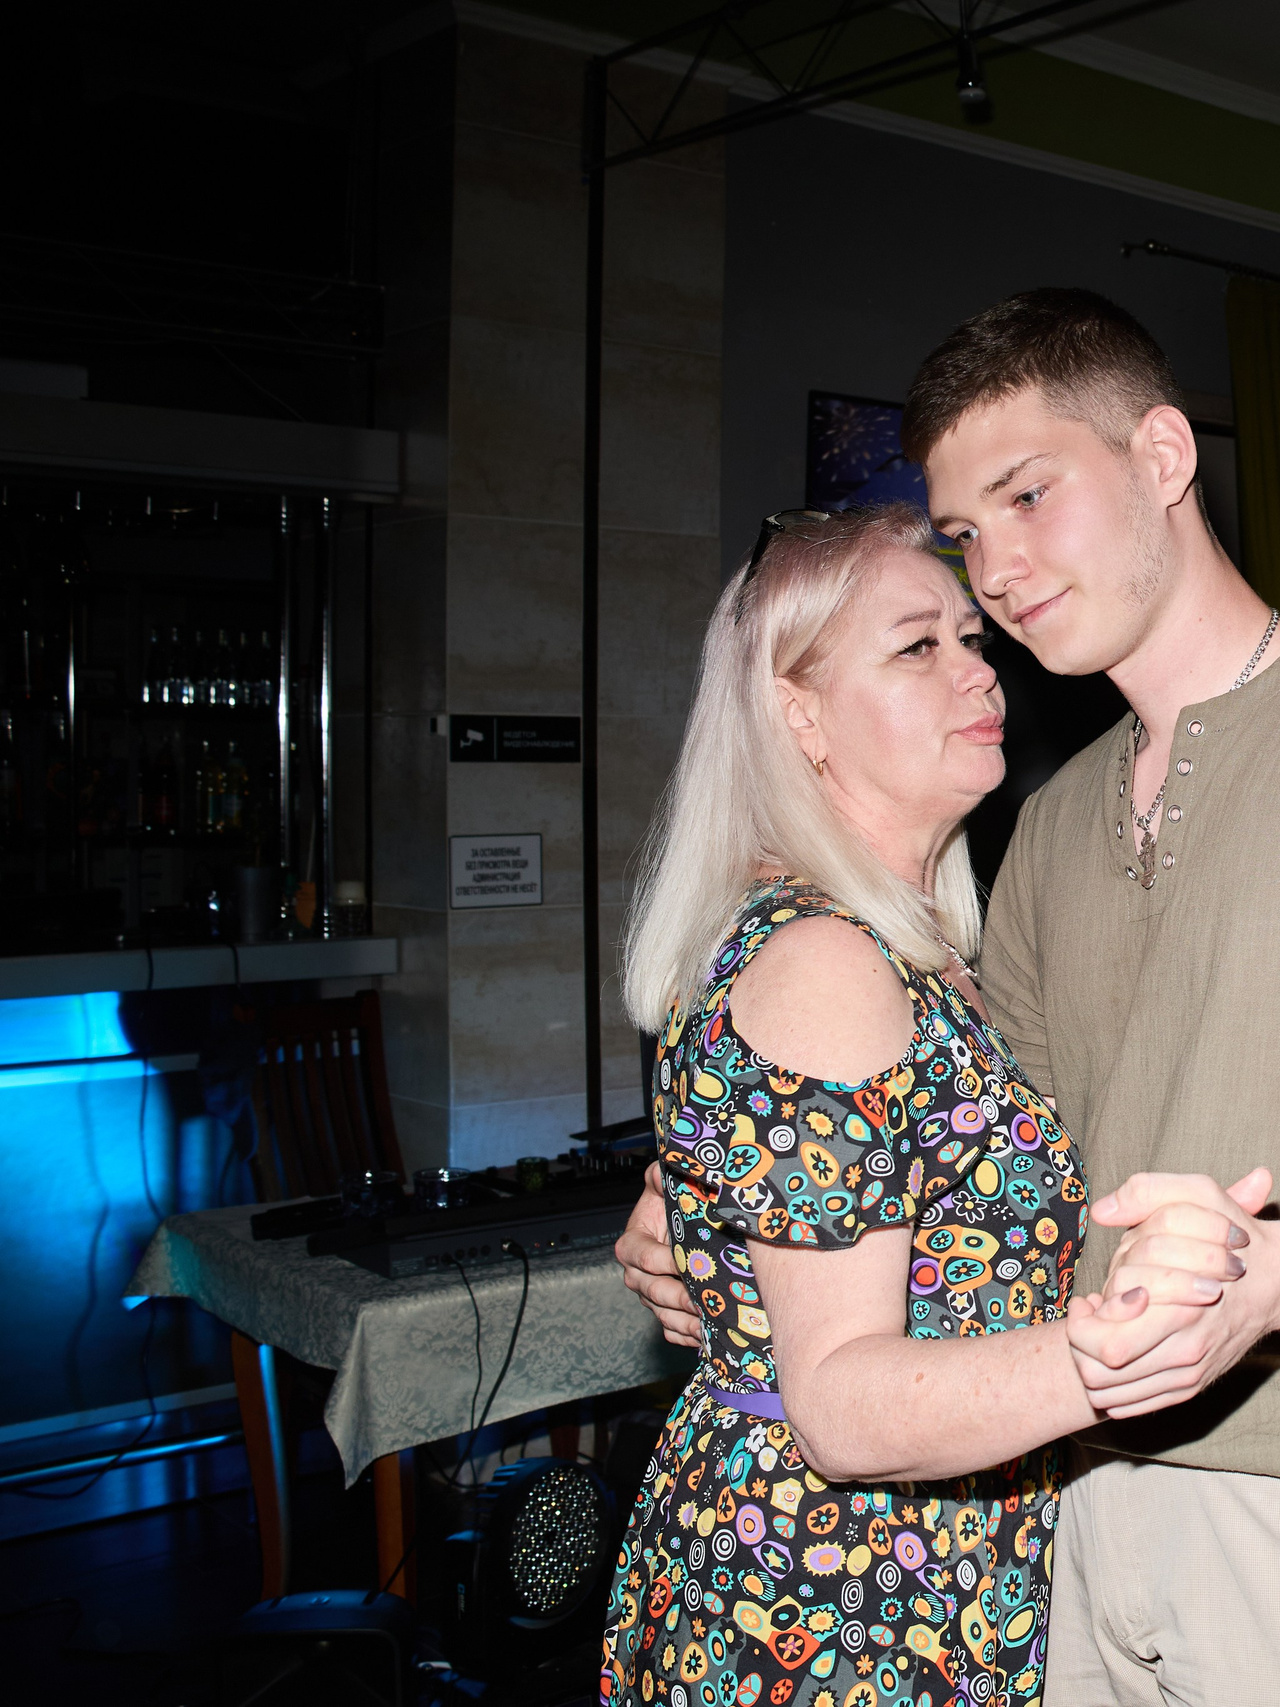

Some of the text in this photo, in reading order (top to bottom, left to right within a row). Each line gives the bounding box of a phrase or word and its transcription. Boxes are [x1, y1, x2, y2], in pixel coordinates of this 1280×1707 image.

[477, 860, 511, 870] ПРИСМОТРА
[472, 871, 521, 883] АДМИНИСТРАЦИЯ
[455, 884, 510, 896] ОТВЕТСТВЕННОСТИ
